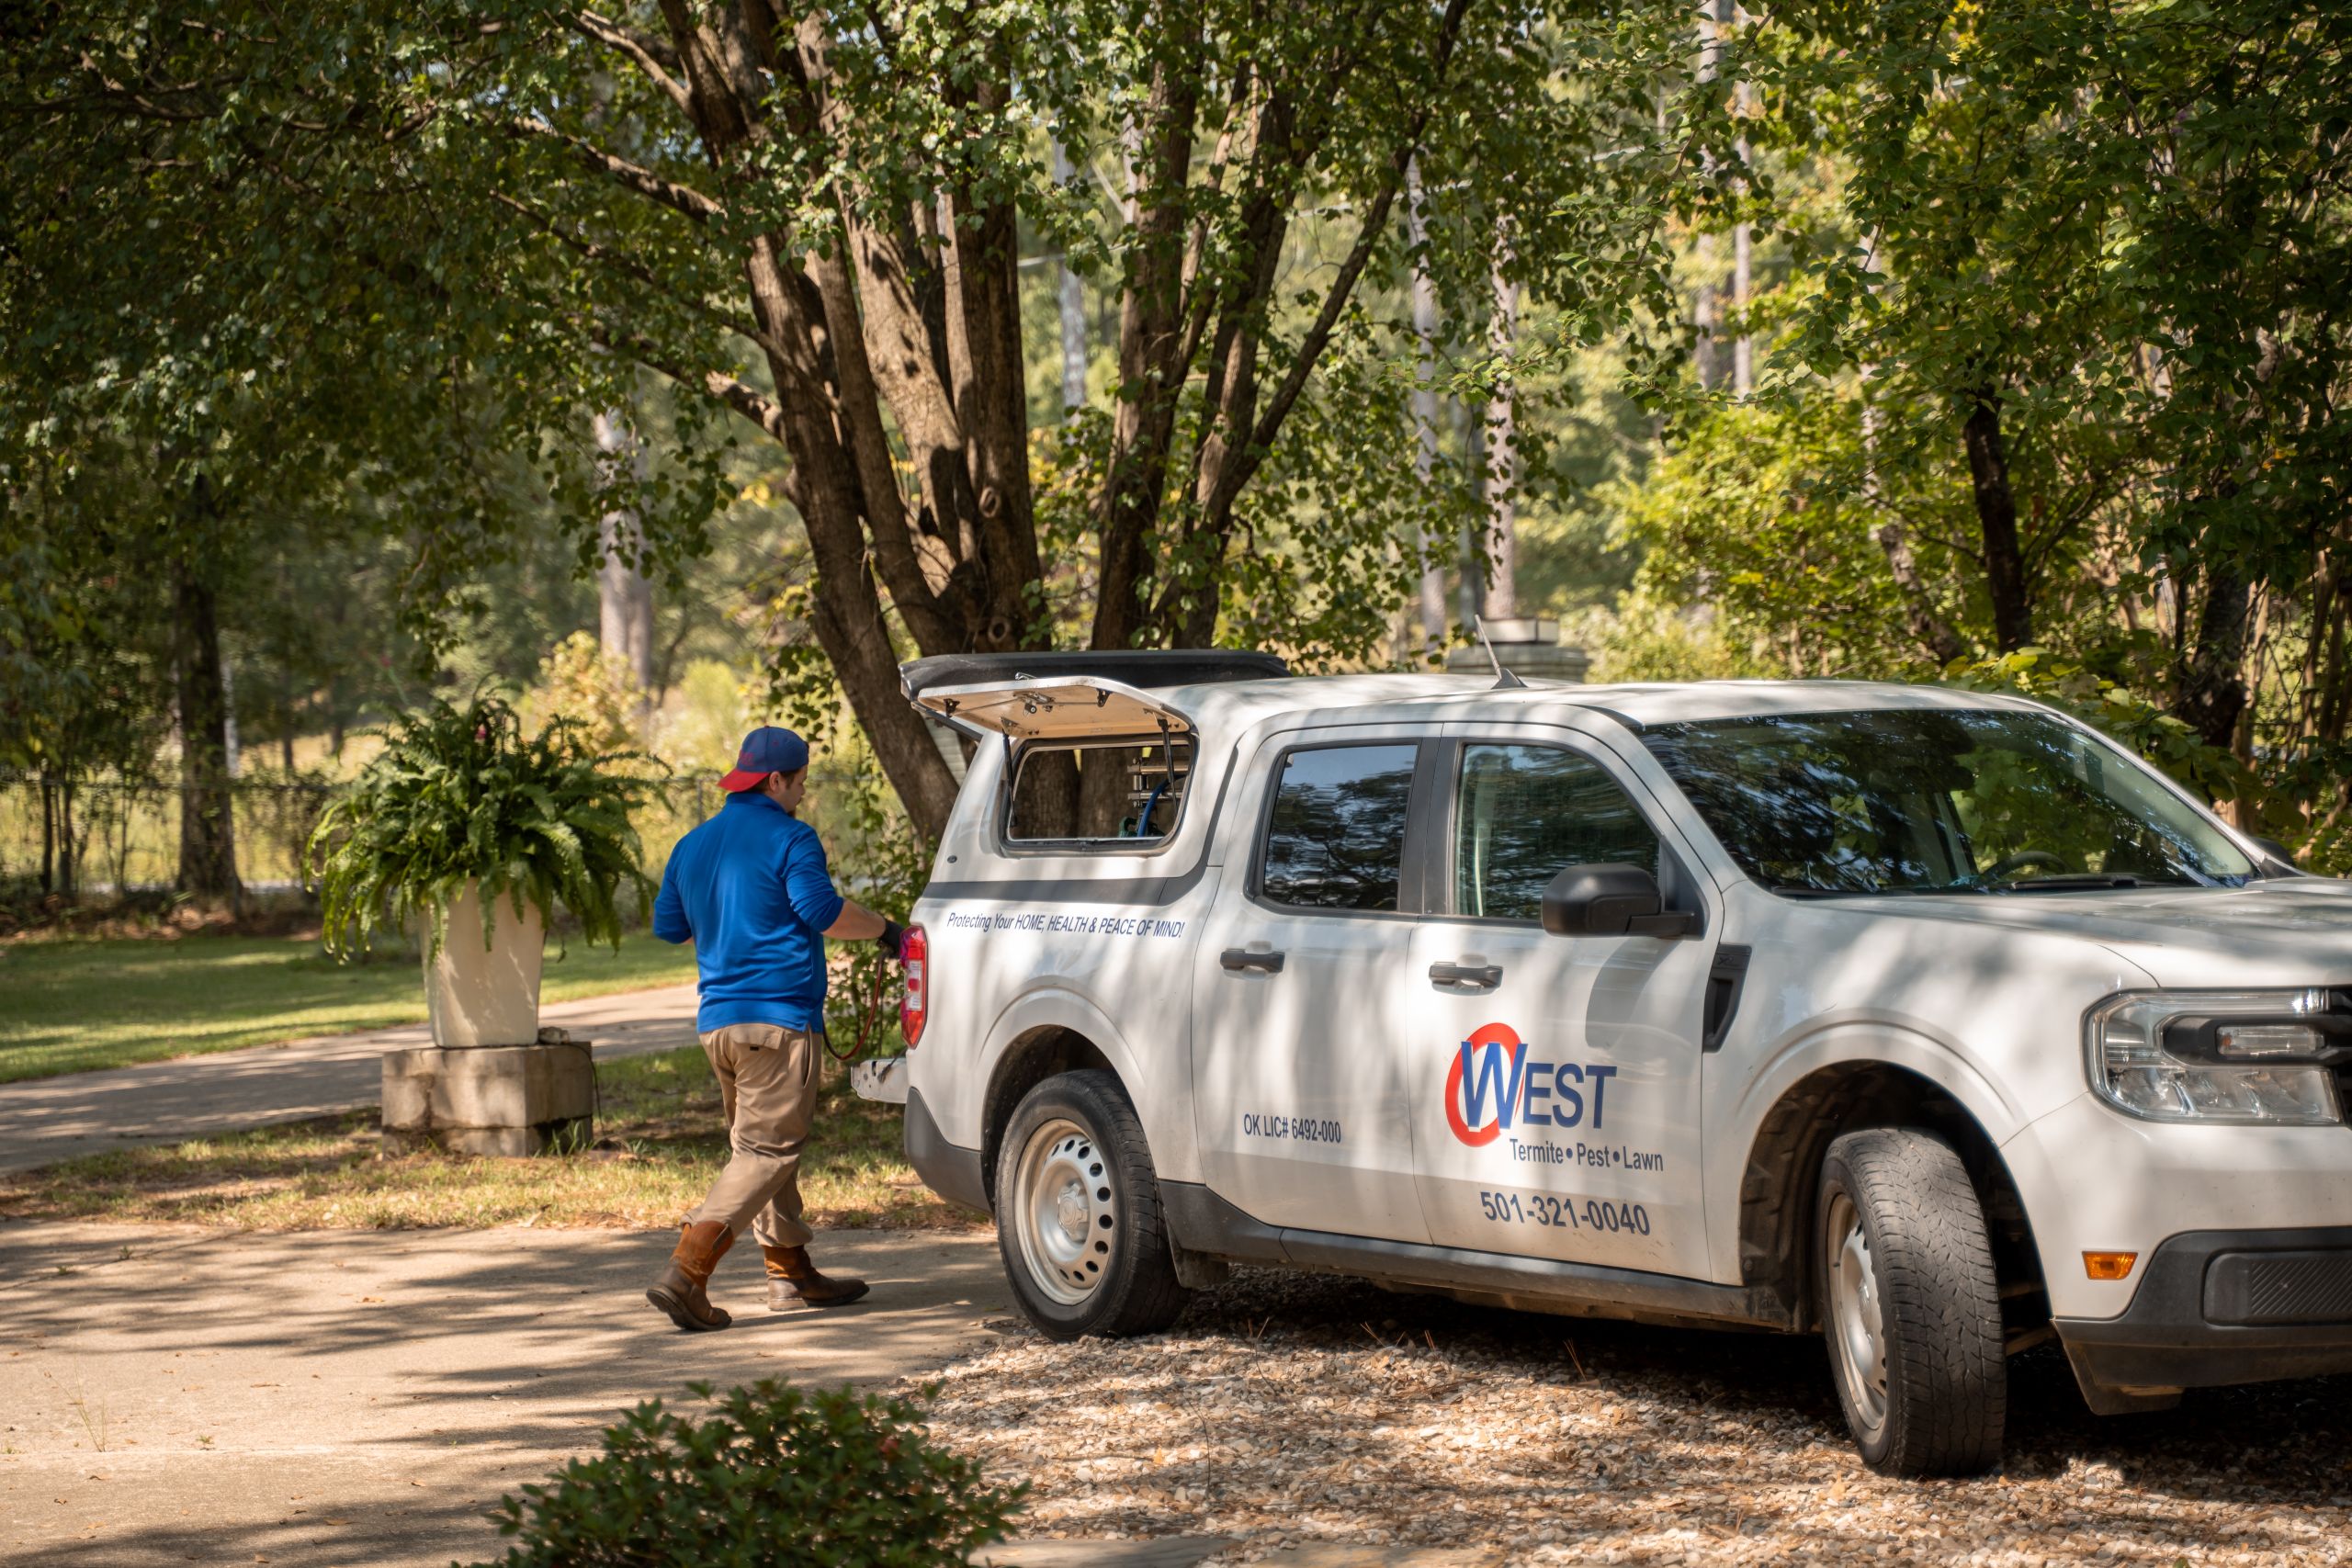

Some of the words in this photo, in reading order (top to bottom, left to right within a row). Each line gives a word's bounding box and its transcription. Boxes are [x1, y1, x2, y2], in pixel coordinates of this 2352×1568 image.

[947, 912, 991, 932] Protecting
[994, 914, 1014, 931] Your
[1015, 914, 1046, 932] HOME,
[1047, 916, 1087, 933] HEALTH
[1089, 918, 1098, 933] &
[1099, 918, 1136, 935] PEACE
[1136, 919, 1152, 937] OF
[1153, 920, 1185, 938] MIND!
[1461, 1041, 1617, 1129] WEST
[1244, 1113, 1261, 1136] OK
[1264, 1115, 1288, 1138] LIC#
[1292, 1118, 1341, 1144] 6492-000
[1480, 1191, 1650, 1235] 501-321-0040
